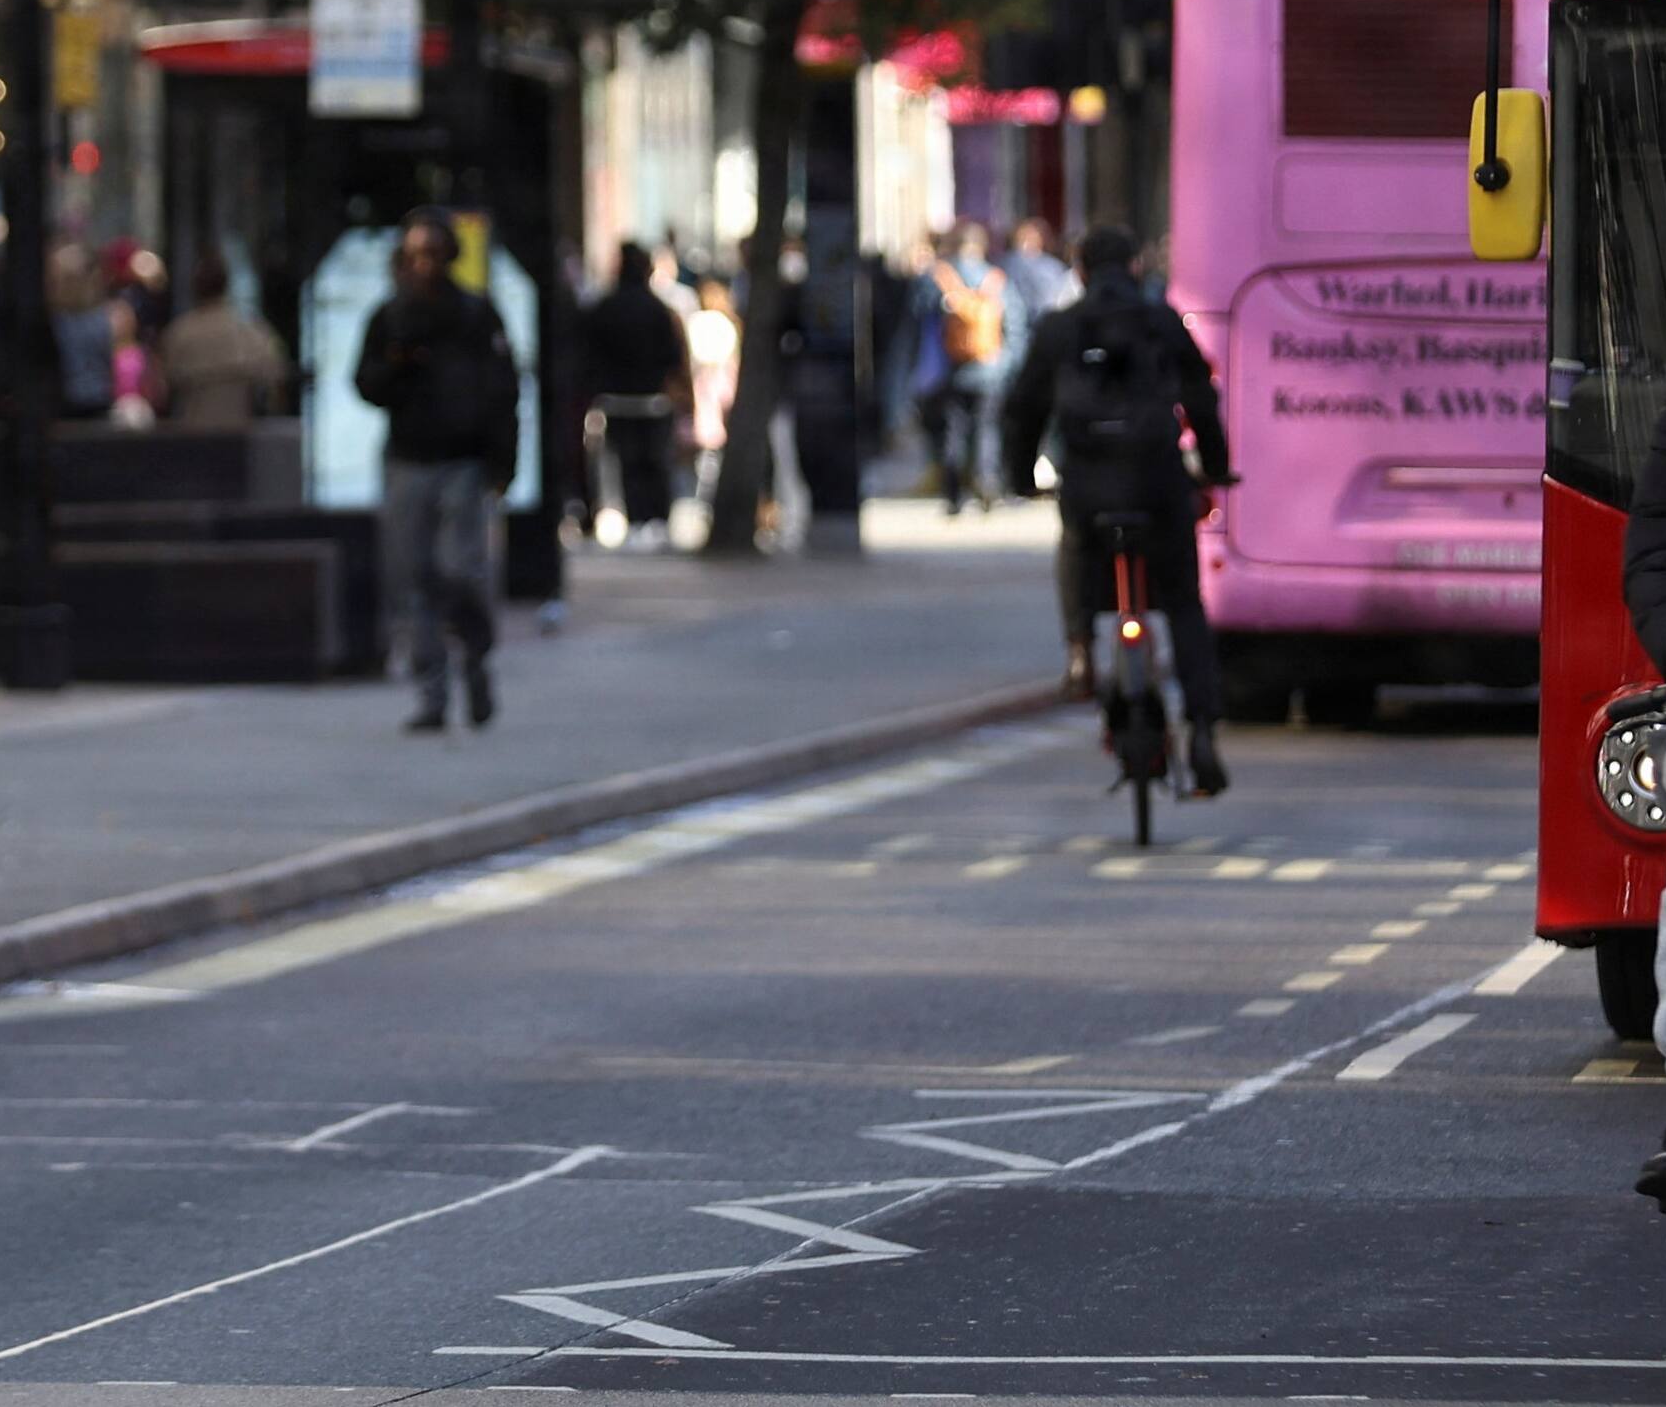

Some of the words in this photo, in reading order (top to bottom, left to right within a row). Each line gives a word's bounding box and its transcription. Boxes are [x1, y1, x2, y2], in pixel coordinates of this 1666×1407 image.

[1317, 276, 1461, 310] Warhol,
[1270, 332, 1411, 372] Banksy,
[1273, 390, 1393, 422] Koons,
[1399, 390, 1519, 421] KAWS
